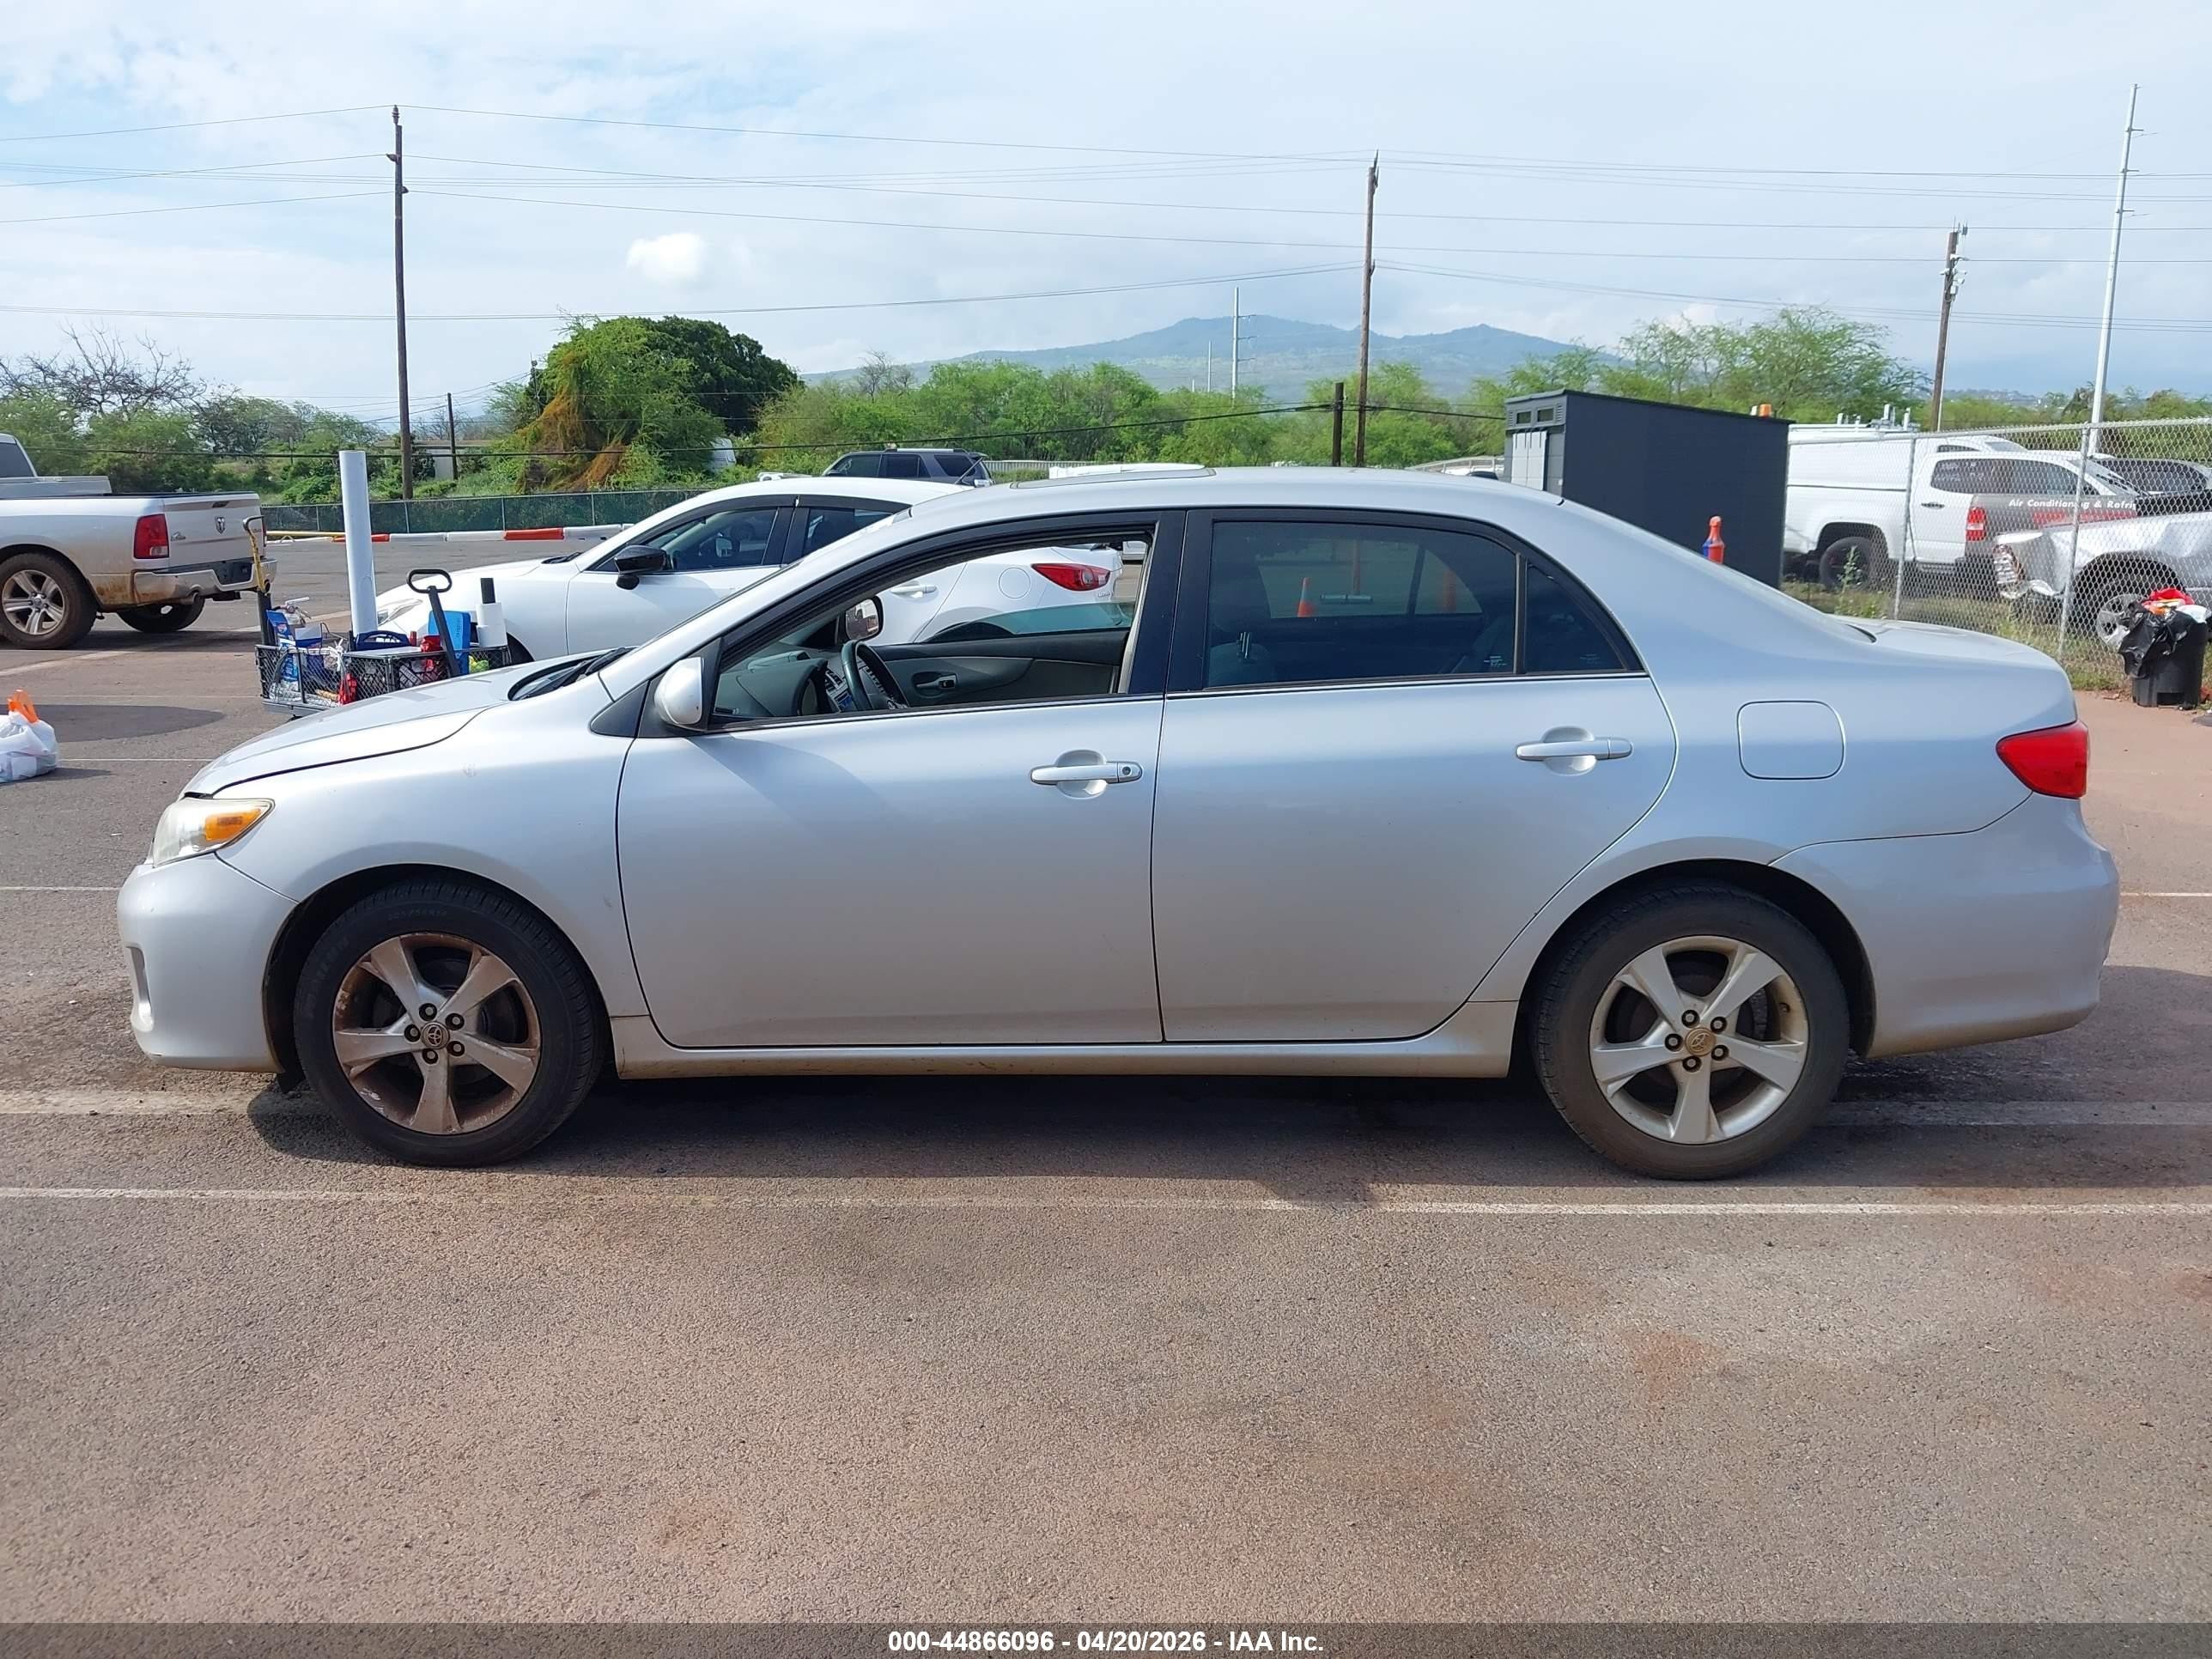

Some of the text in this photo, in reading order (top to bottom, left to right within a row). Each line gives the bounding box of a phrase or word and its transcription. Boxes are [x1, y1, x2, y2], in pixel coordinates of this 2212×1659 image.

[2008, 498, 2024, 507] Air
[2027, 498, 2090, 510] Conditiong
[2094, 500, 2102, 508] &
